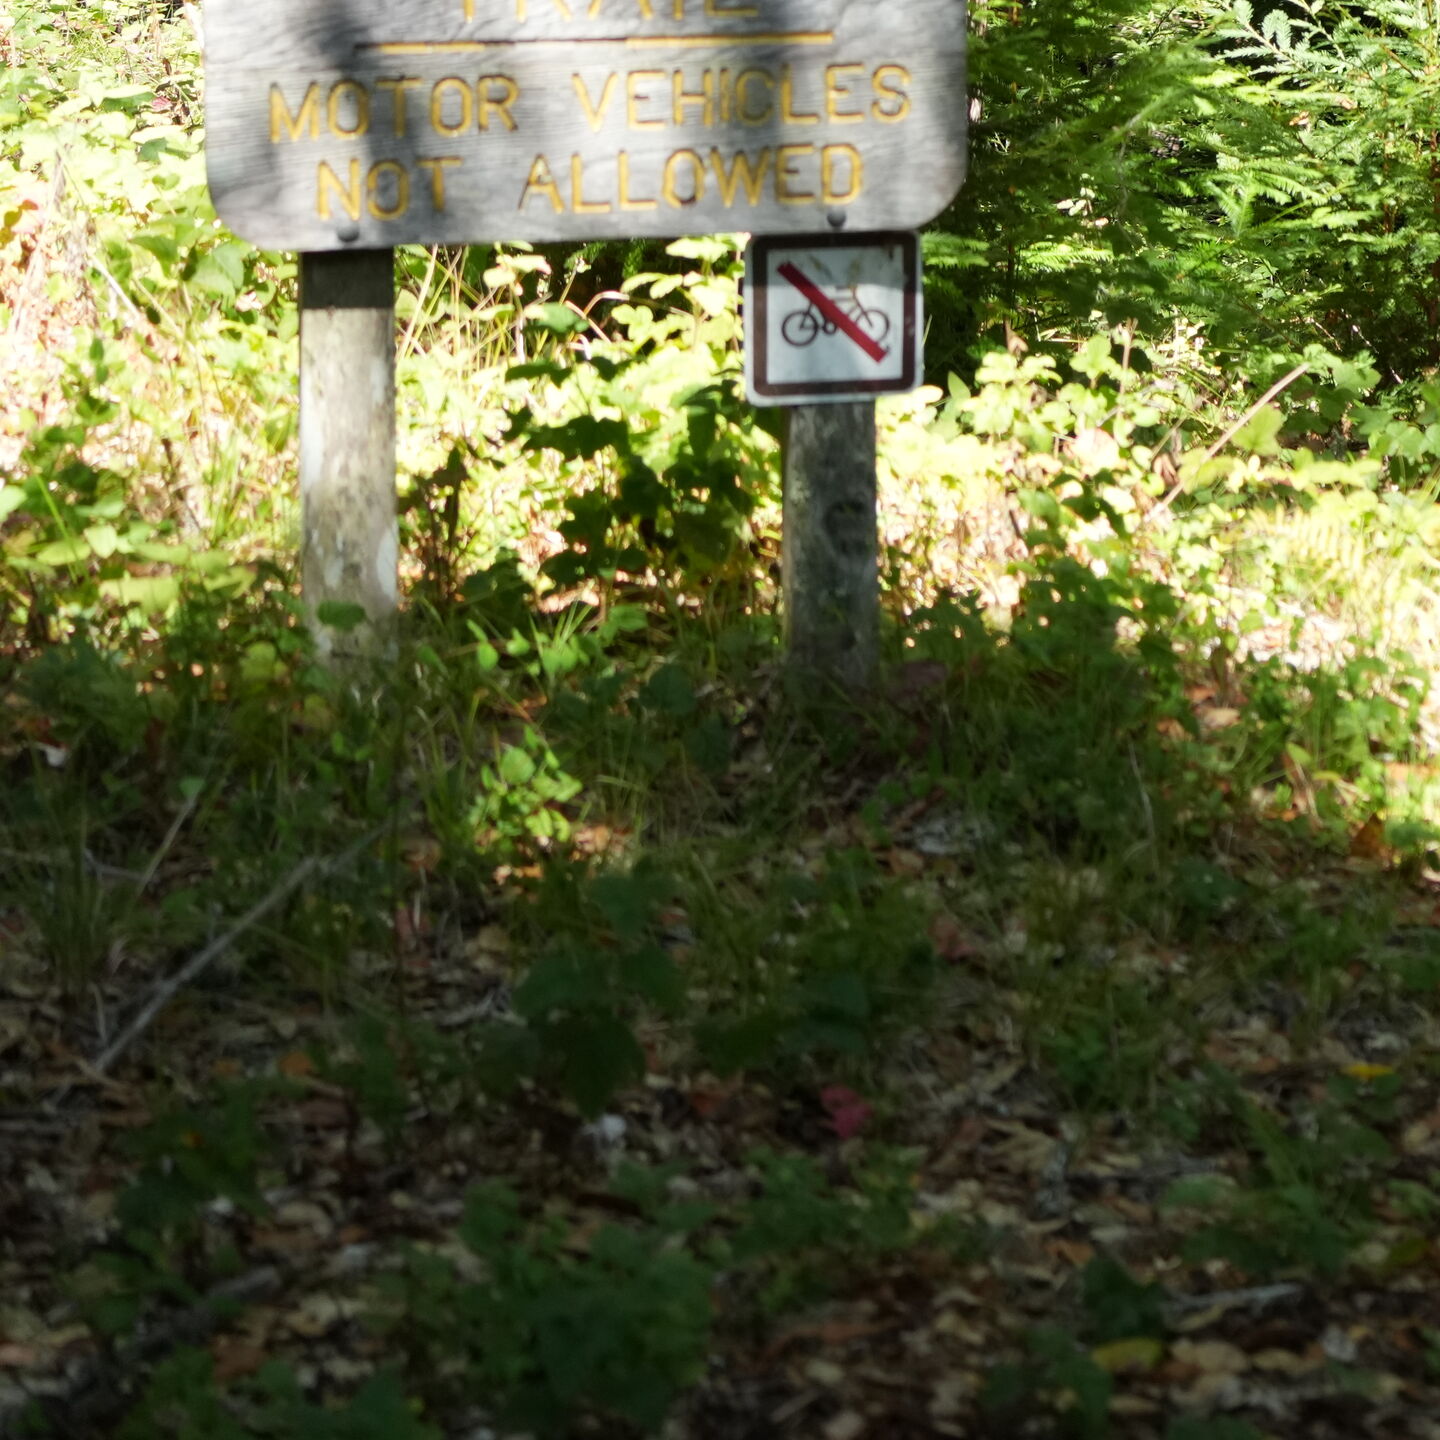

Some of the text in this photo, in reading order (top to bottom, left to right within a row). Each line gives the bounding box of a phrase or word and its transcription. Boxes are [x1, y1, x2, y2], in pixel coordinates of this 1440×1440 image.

[268, 63, 912, 143] MOTOR VEHICLES
[315, 144, 864, 221] NOT ALLOWED
